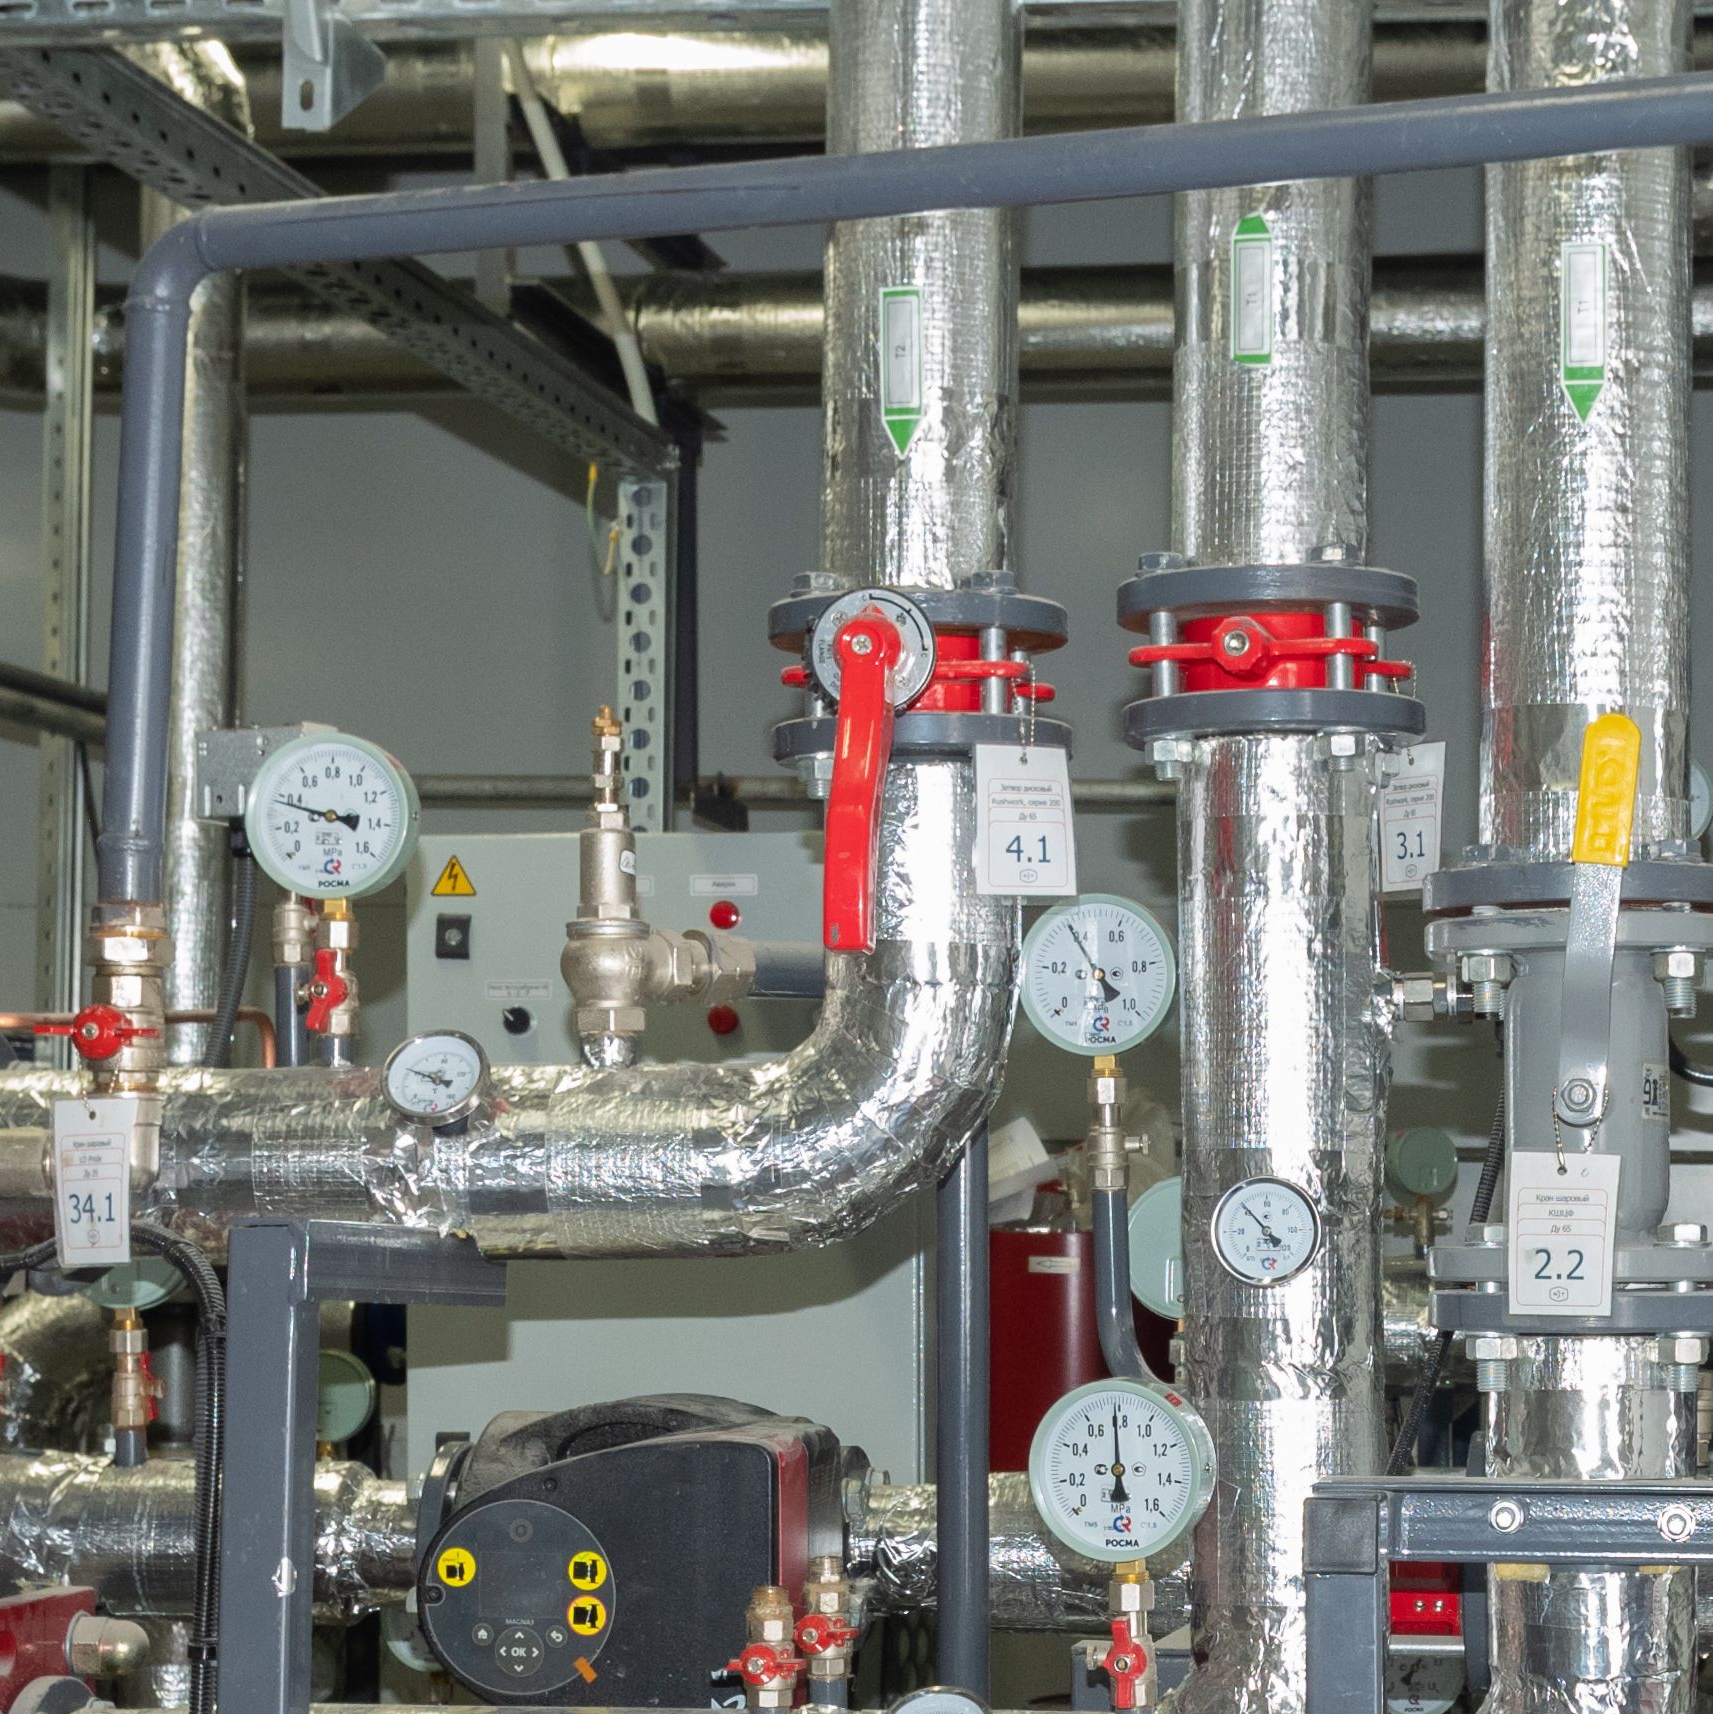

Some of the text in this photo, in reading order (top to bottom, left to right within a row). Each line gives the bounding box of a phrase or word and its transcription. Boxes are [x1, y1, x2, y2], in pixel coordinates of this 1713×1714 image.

[325, 767, 340, 780] 0,8
[302, 776, 318, 788] 0,6
[349, 774, 362, 787] 1,0
[364, 792, 377, 803] 1,2
[284, 822, 299, 834] 0,2
[368, 818, 381, 830] 1,4
[323, 847, 342, 856] MPa
[356, 842, 369, 854] 1,6
[1005, 835, 1052, 864] 4.1
[1396, 830, 1425, 860] 3.1
[1109, 931, 1124, 943] 0,6
[1052, 962, 1067, 974] 0,2
[1132, 961, 1147, 974] 0,8
[1123, 999, 1136, 1011] 1,0
[1535, 1193, 1590, 1203] Кран шаровый
[69, 1192, 115, 1224] 34.1
[1550, 1224, 1572, 1233] Ду 65
[1534, 1248, 1584, 1280] 2.2
[1087, 1424, 1104, 1438] 0,6
[1137, 1424, 1152, 1438] 1,0
[1072, 1443, 1088, 1457] 0,4
[1153, 1444, 1168, 1457] 1,2
[1069, 1473, 1085, 1487] 0,2
[1158, 1473, 1172, 1487] 1,4
[1080, 1494, 1087, 1507] 0
[1145, 1498, 1160, 1512] 1,6
[1110, 1504, 1131, 1514] MPa
[511, 1647, 527, 1657] OK
